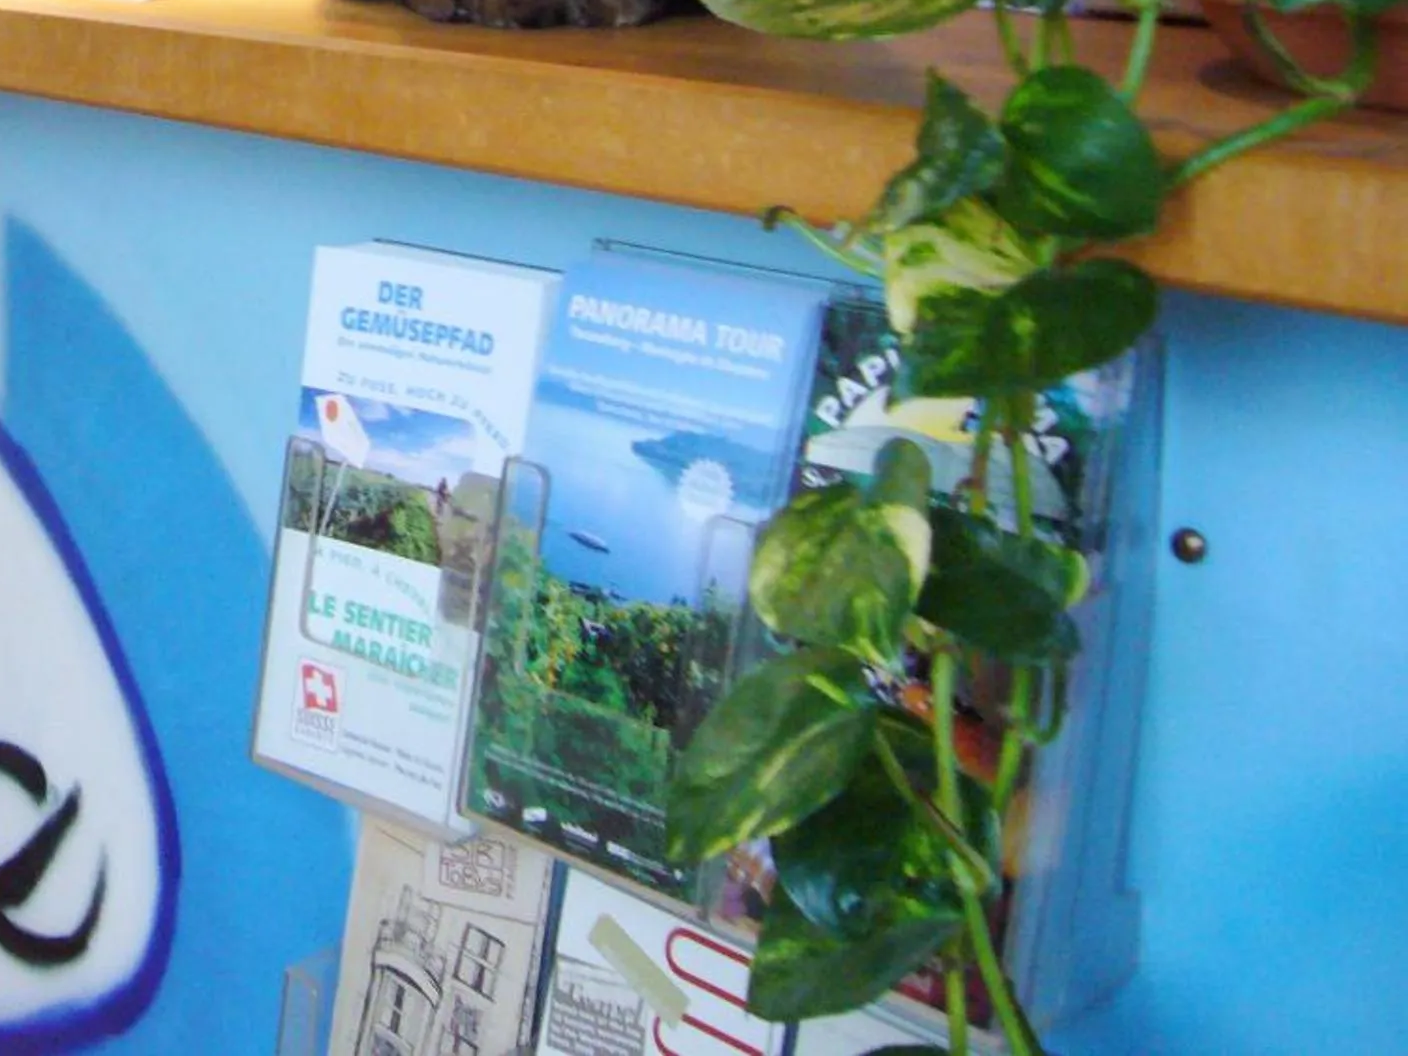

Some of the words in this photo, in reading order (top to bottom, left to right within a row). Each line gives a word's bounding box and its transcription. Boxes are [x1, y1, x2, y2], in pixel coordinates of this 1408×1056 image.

[377, 280, 424, 311] DER
[567, 293, 709, 346] PANORAMA
[713, 323, 786, 363] TOUR
[306, 592, 336, 619] LE
[342, 599, 434, 647] SENTIER
